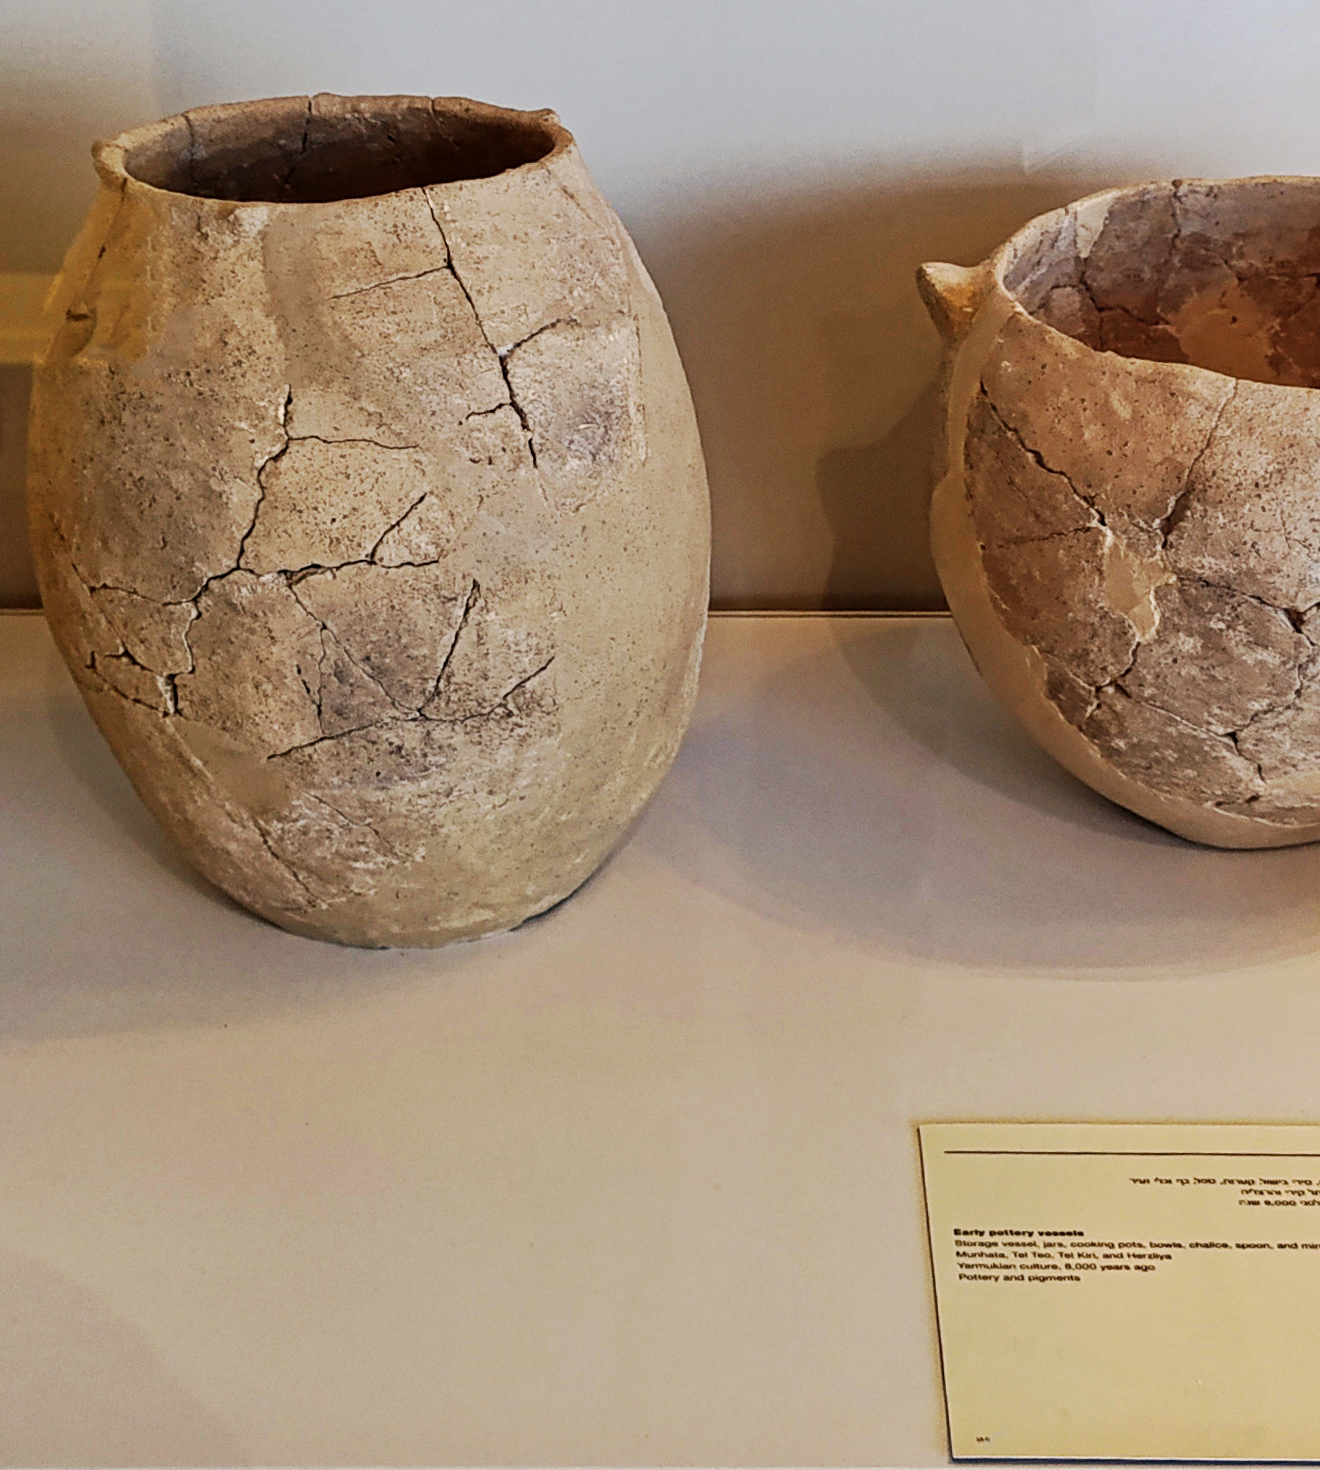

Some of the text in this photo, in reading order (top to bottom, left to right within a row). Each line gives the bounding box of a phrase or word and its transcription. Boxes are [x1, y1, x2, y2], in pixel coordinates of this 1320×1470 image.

[953, 1229, 985, 1237] Early
[989, 1229, 1034, 1237] pottery
[955, 1240, 998, 1248] Storage
[1070, 1241, 1115, 1249] cooking
[1149, 1241, 1186, 1249] bowls,
[956, 1251, 1008, 1259] Munhata,
[1127, 1252, 1172, 1261] Herzliya
[957, 1262, 1016, 1270] Yarmukian
[958, 1273, 1000, 1282] Pottery
[1028, 1275, 1081, 1283] pigments
